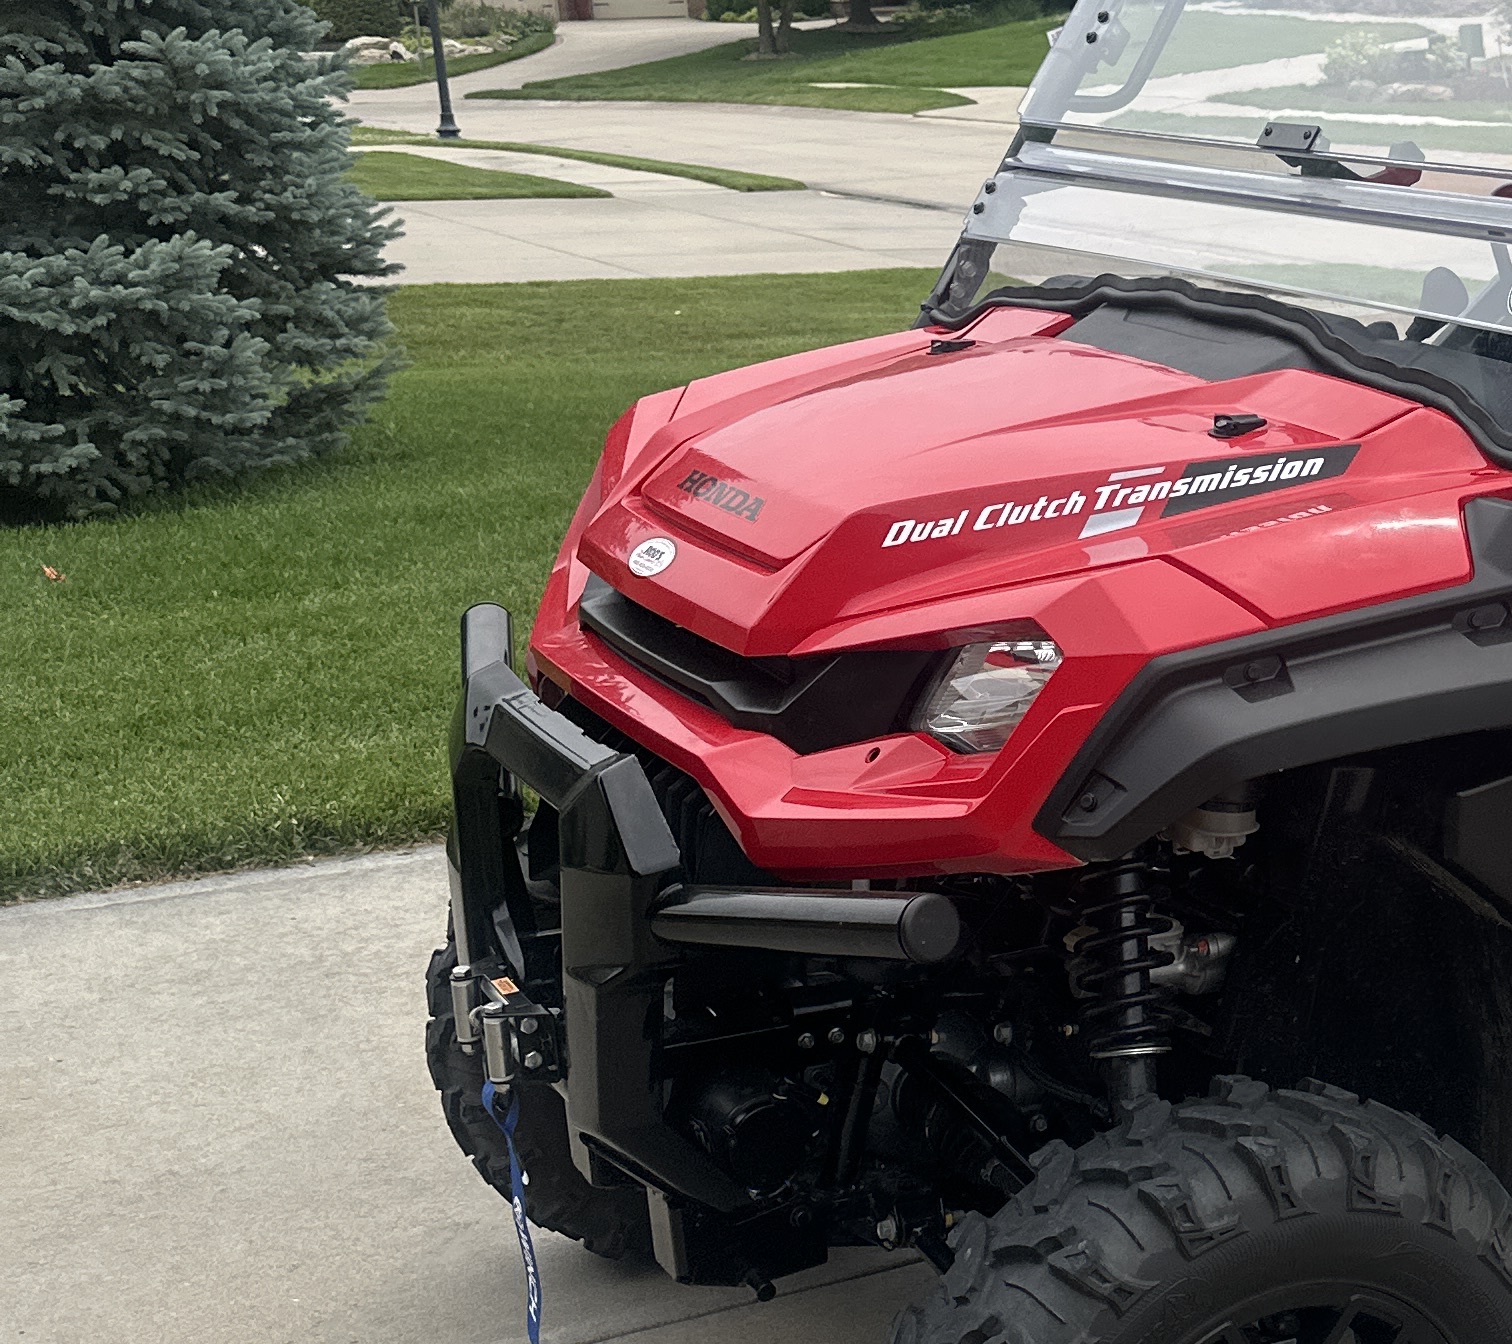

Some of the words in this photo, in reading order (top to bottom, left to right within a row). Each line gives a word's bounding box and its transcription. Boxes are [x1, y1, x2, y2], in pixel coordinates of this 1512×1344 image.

[677, 469, 766, 523] HONDA
[881, 512, 968, 548] Dual
[973, 490, 1086, 532] Clutch
[1093, 456, 1325, 511] Transmission
